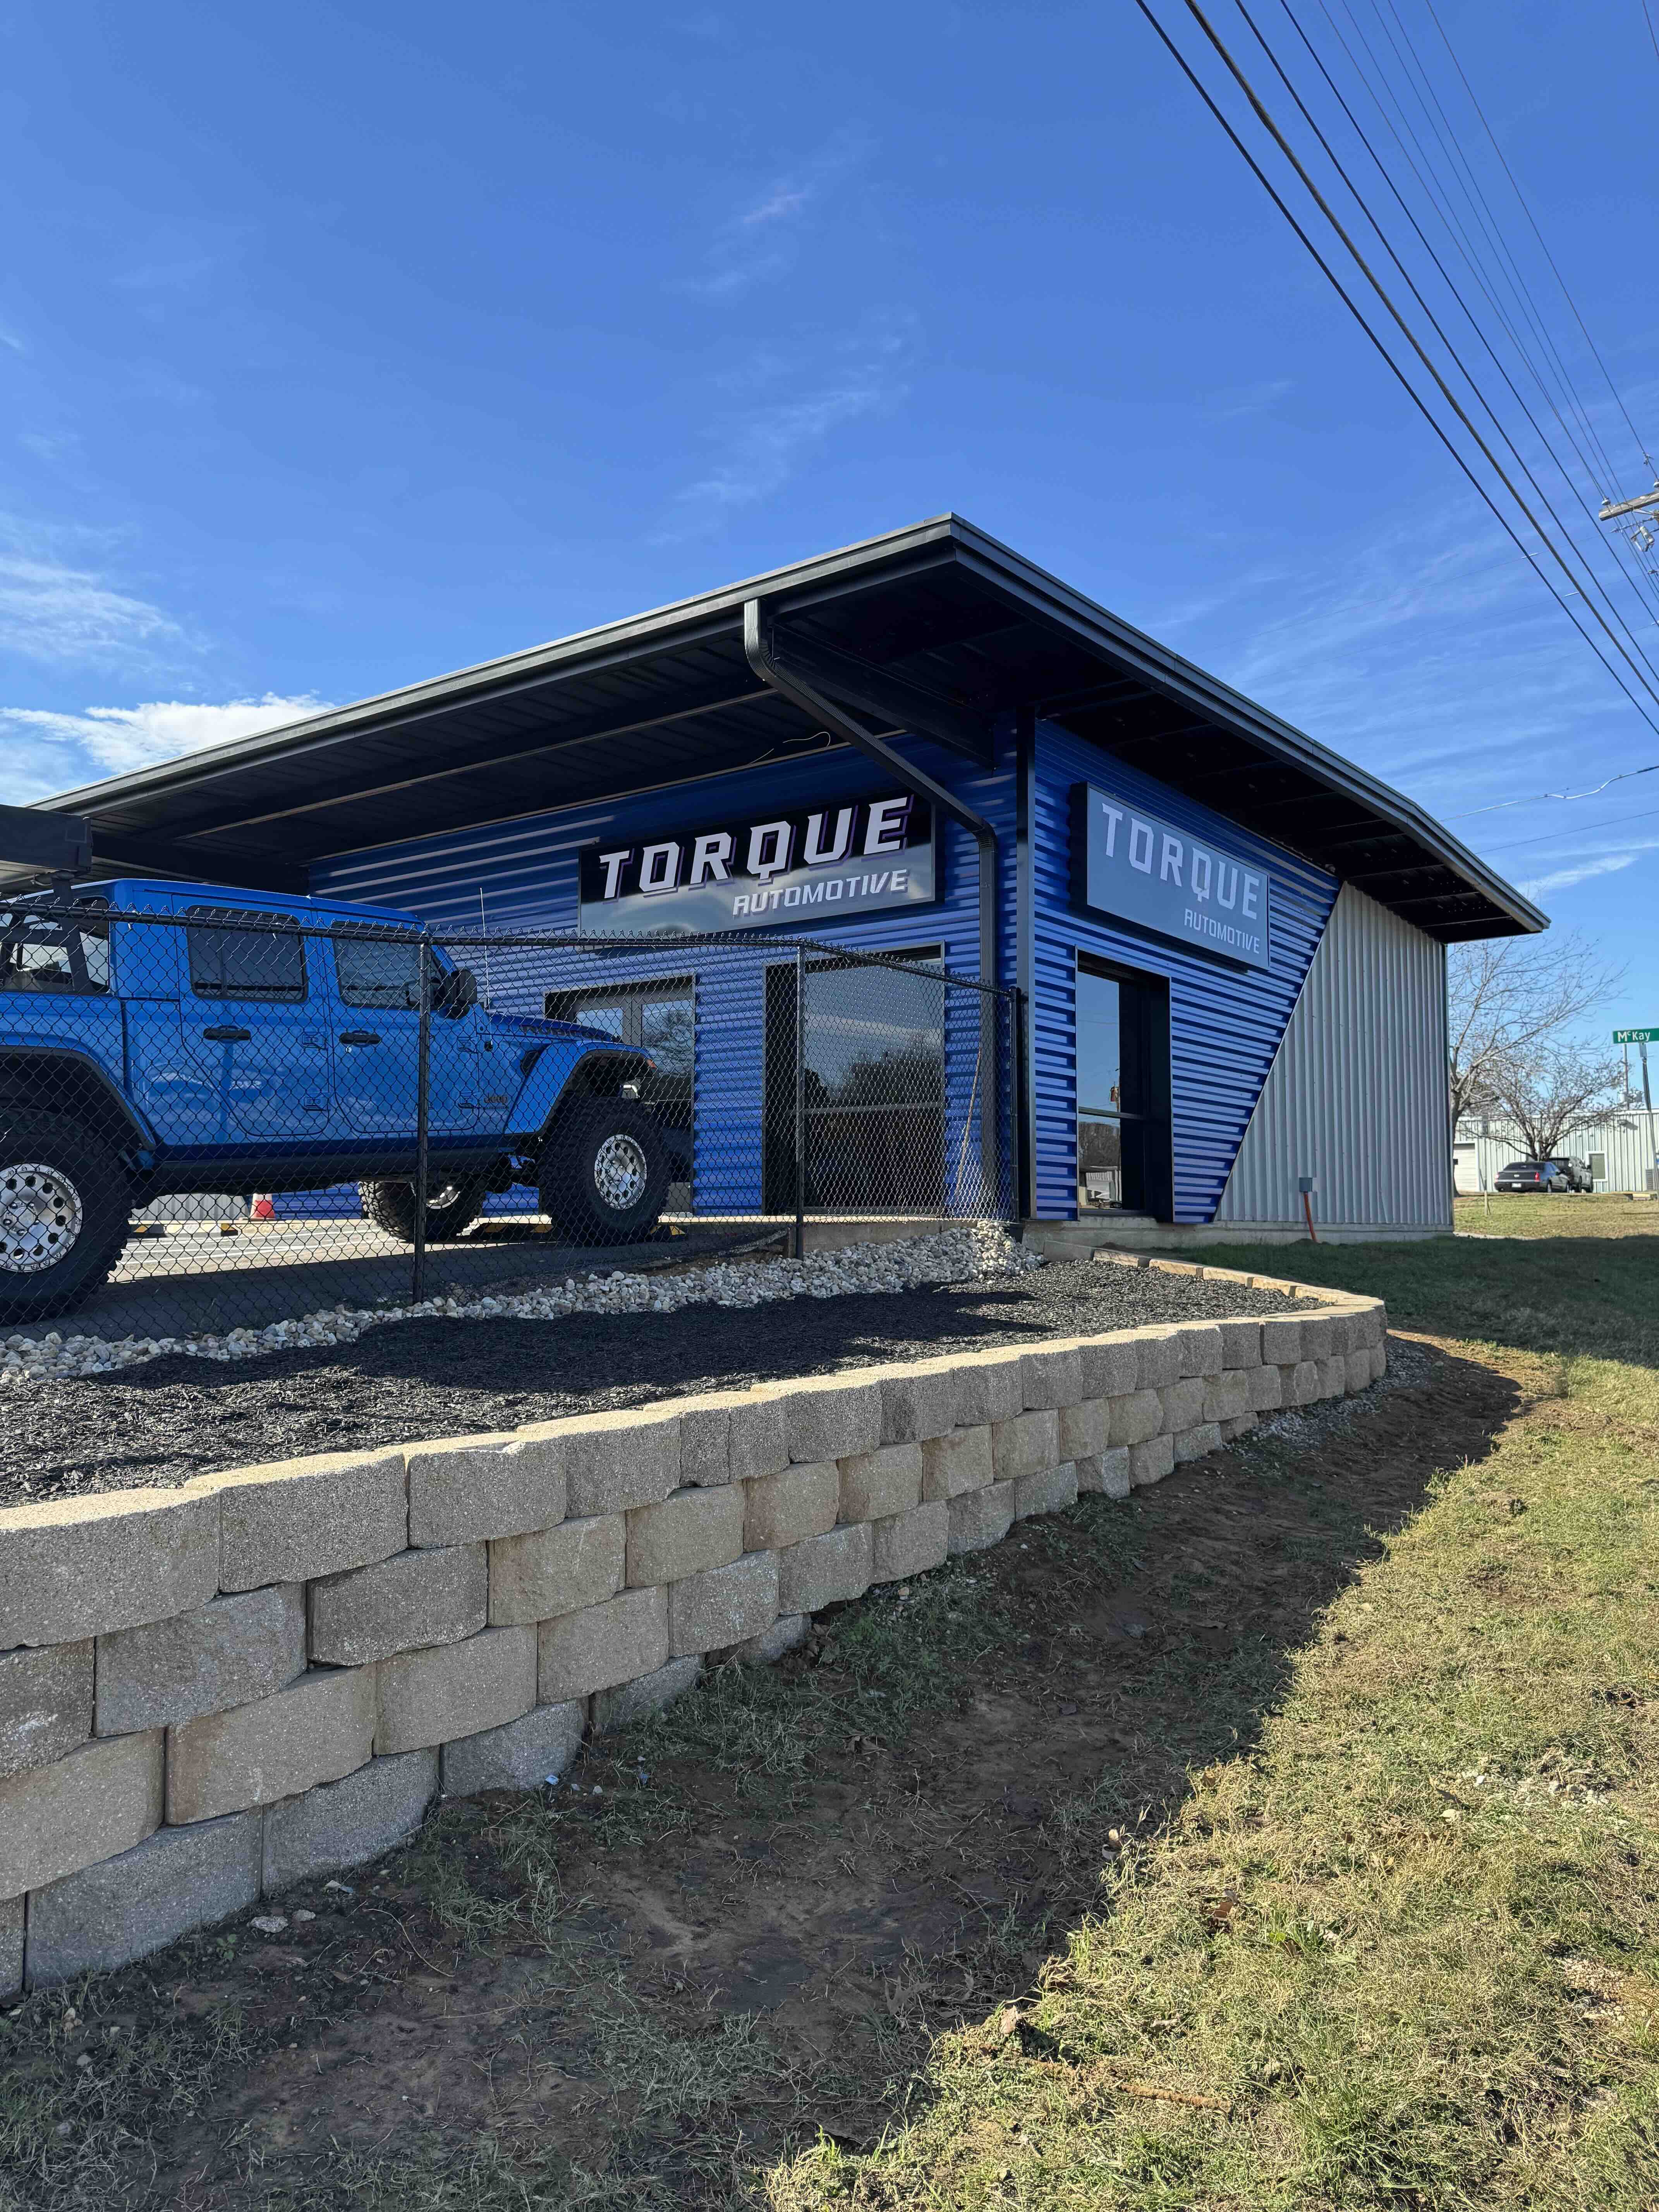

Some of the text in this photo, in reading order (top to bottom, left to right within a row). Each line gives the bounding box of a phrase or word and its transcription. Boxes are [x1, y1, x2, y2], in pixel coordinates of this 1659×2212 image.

[599, 797, 908, 899] TORQUE
[1101, 803, 1259, 920] TORQUE
[732, 869, 908, 916] AUTOMOTIVE
[1184, 908, 1260, 954] AUTOMOTIVE
[1617, 1030, 1650, 1042] McKay
